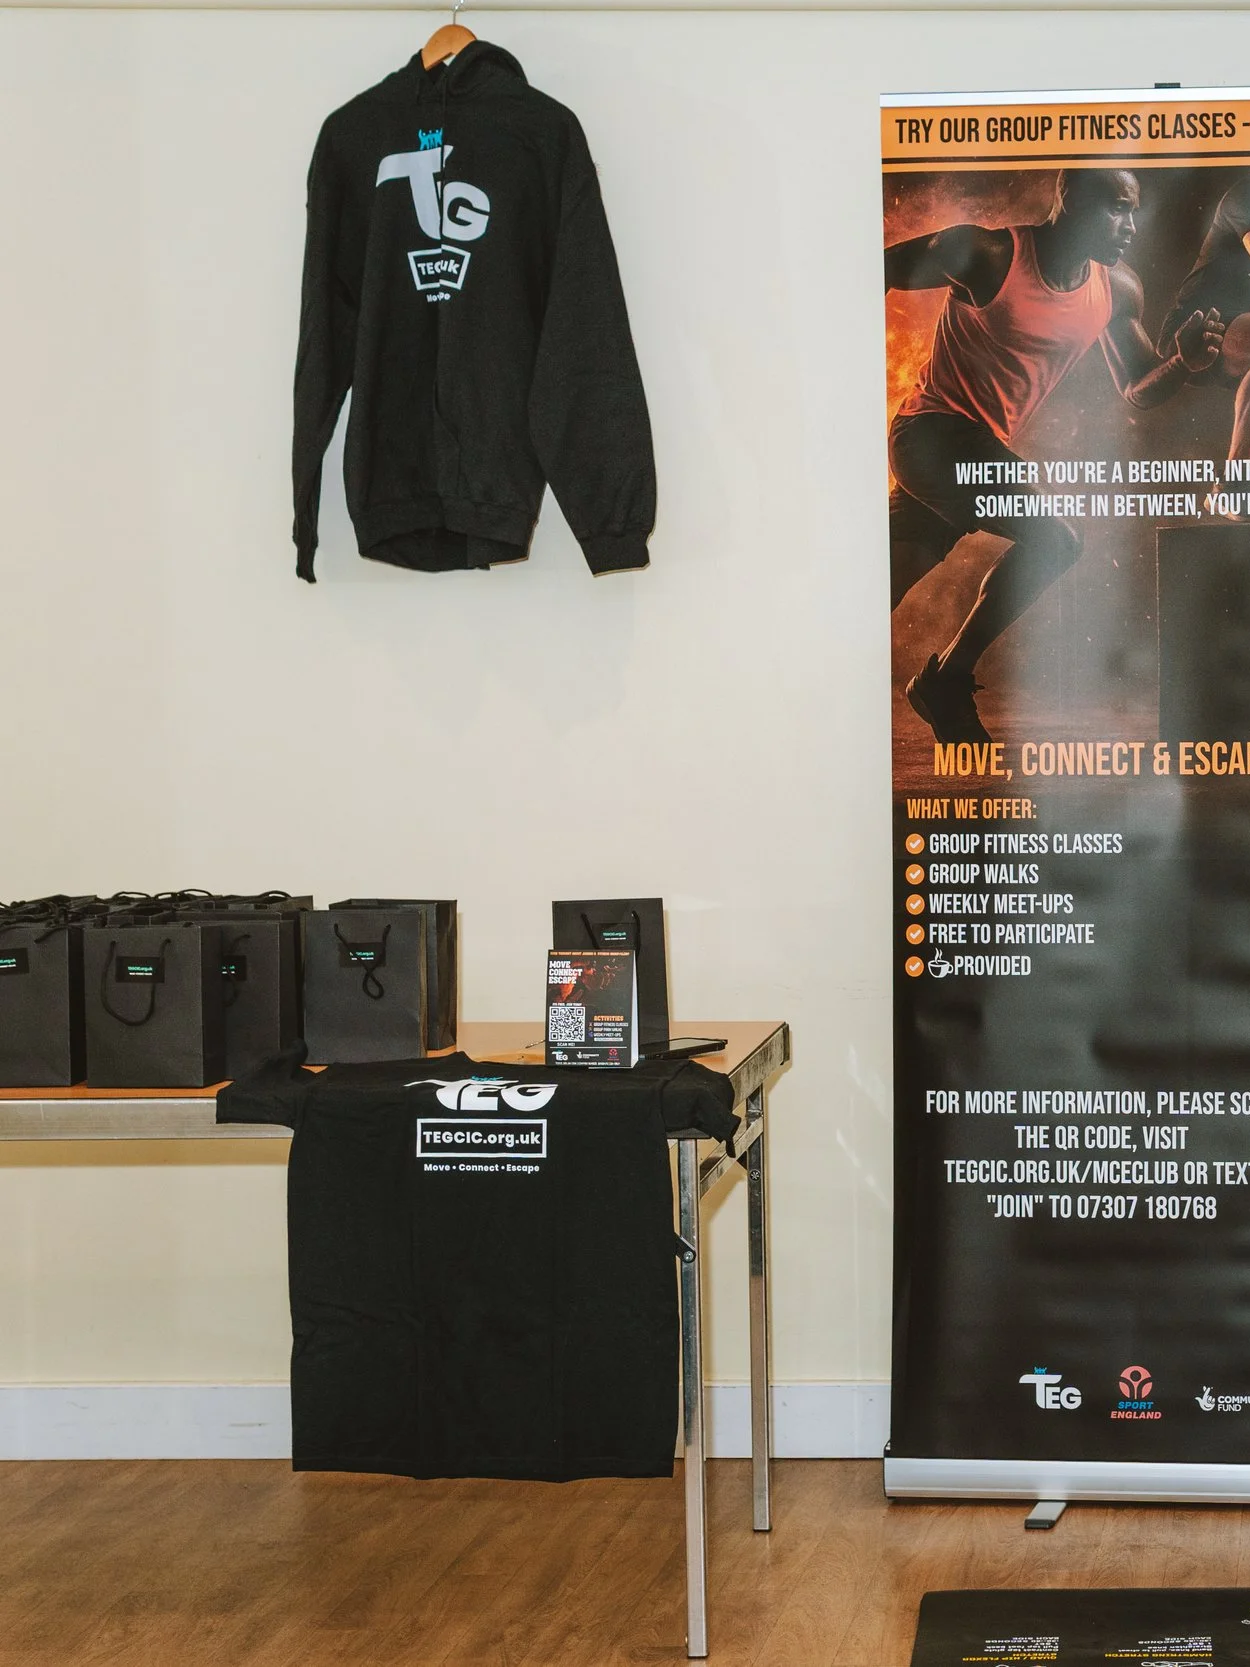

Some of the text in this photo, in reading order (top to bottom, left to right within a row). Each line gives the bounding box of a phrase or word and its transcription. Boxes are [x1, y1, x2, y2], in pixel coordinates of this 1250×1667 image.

[895, 119, 933, 143] TRY
[940, 118, 979, 142] OUR
[986, 116, 1052, 141] GROUP
[1059, 114, 1142, 140] FITNESS
[1148, 112, 1236, 139] CLASSES
[956, 462, 1038, 484] WHETHER
[1043, 461, 1106, 483] YOU'RE
[1112, 461, 1123, 483] A
[1129, 460, 1219, 485] BEGINNER,
[975, 495, 1086, 518] SOMEWHERE
[1092, 494, 1108, 517] IN
[1114, 494, 1201, 519] BETWEEN,
[934, 743, 1012, 781] MOVE,
[1022, 743, 1145, 776] CONNECT
[1153, 742, 1171, 775] &
[907, 799, 1037, 819] WHAT WE OFFER:
[929, 833, 1123, 854] GROUP FITNESS CLASSES
[929, 864, 1039, 884] GROUP WALKS
[929, 894, 1074, 914] WEEKLY MEET-UPS
[929, 924, 1095, 944] FREE TO PARTICIPATE
[549, 960, 571, 968] MOVE
[549, 969, 583, 977] CONNECT
[954, 955, 1031, 976] PROVIDED
[548, 977, 577, 985] ESCAPE
[404, 1079, 558, 1111] TEG
[926, 1090, 960, 1114] FOR
[965, 1090, 1017, 1114] MORE
[1022, 1090, 1152, 1118] INFORMATION,
[1157, 1091, 1225, 1115] PLEASE
[423, 1131, 541, 1147] TEGCIC.org.uk
[1014, 1125, 1189, 1152] THE QR CODE, VISIT
[424, 1164, 540, 1174] Move Connect Escape
[944, 1160, 1178, 1184] TEGCIC.ORG.UK/MCECLUB
[1183, 1161, 1208, 1185] OR
[987, 1195, 1217, 1220] "JOIN" TO 07307 180768
[1019, 1374, 1082, 1410] TEG
[1110, 1411, 1162, 1420] ENGLAND
[1118, 1401, 1154, 1410] SPORT
[1217, 1404, 1242, 1412] FUND
